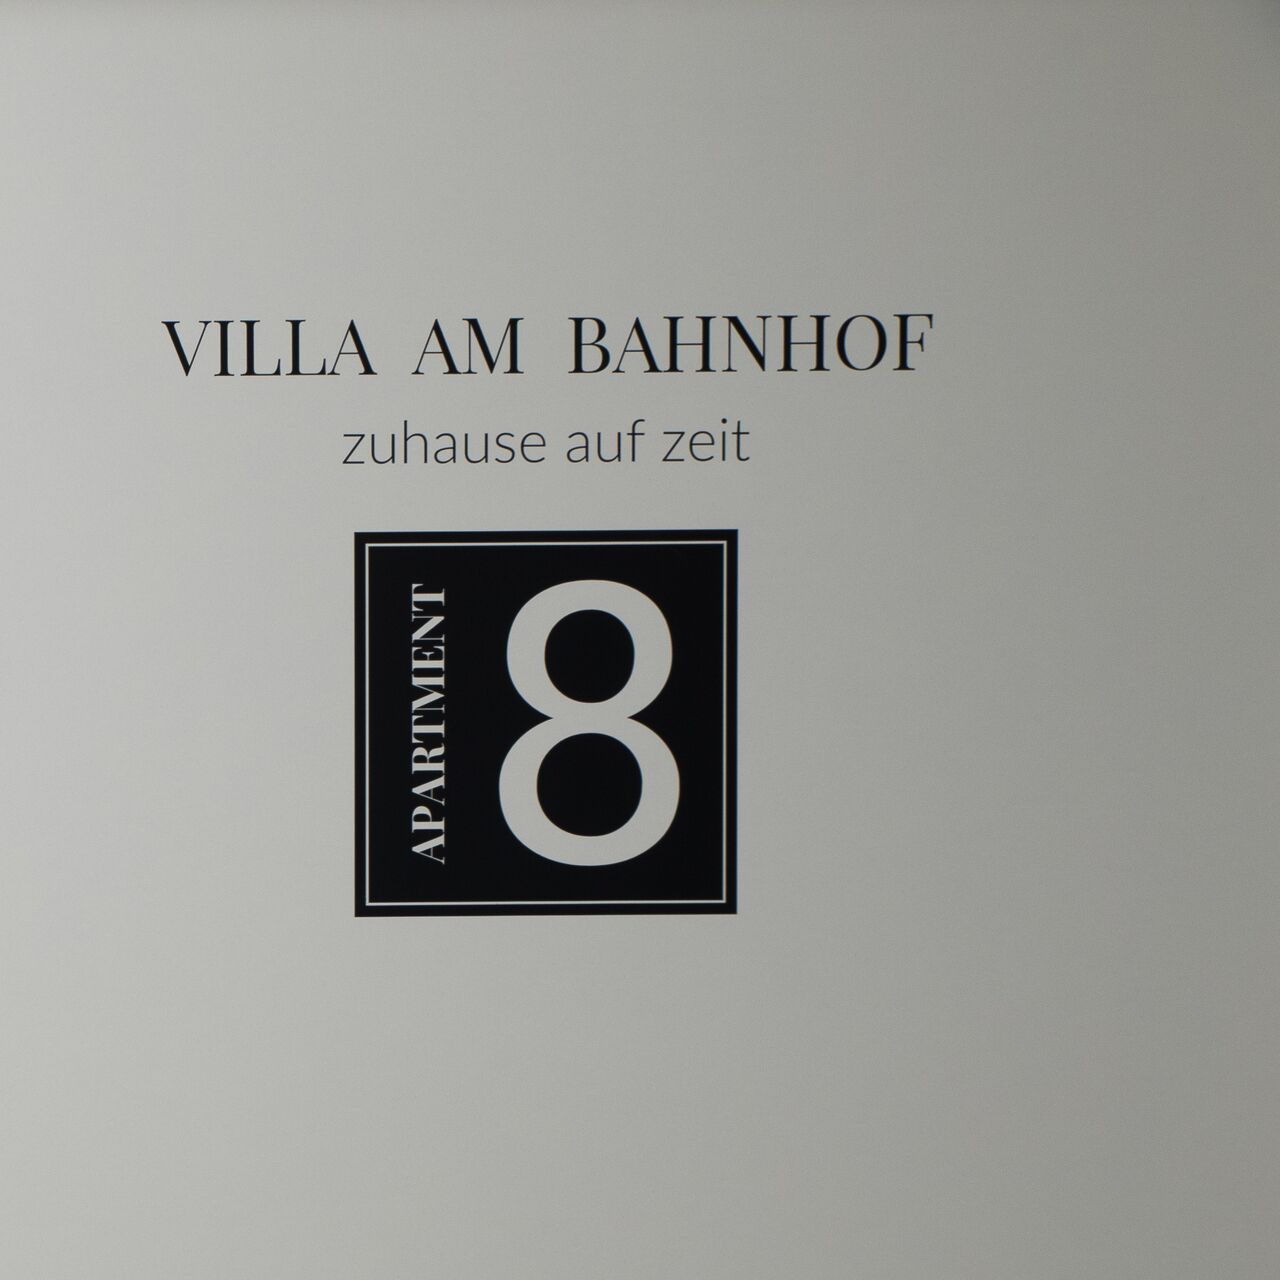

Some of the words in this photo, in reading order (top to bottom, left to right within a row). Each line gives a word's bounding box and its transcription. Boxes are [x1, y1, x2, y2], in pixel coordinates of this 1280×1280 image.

[162, 320, 377, 376] VILLA
[412, 318, 523, 374] AM
[568, 314, 933, 373] BAHNHOF
[343, 420, 545, 464] zuhause
[567, 419, 645, 463] auf
[663, 418, 749, 461] zeit
[412, 584, 444, 864] APARTMENT
[499, 580, 679, 866] 8
